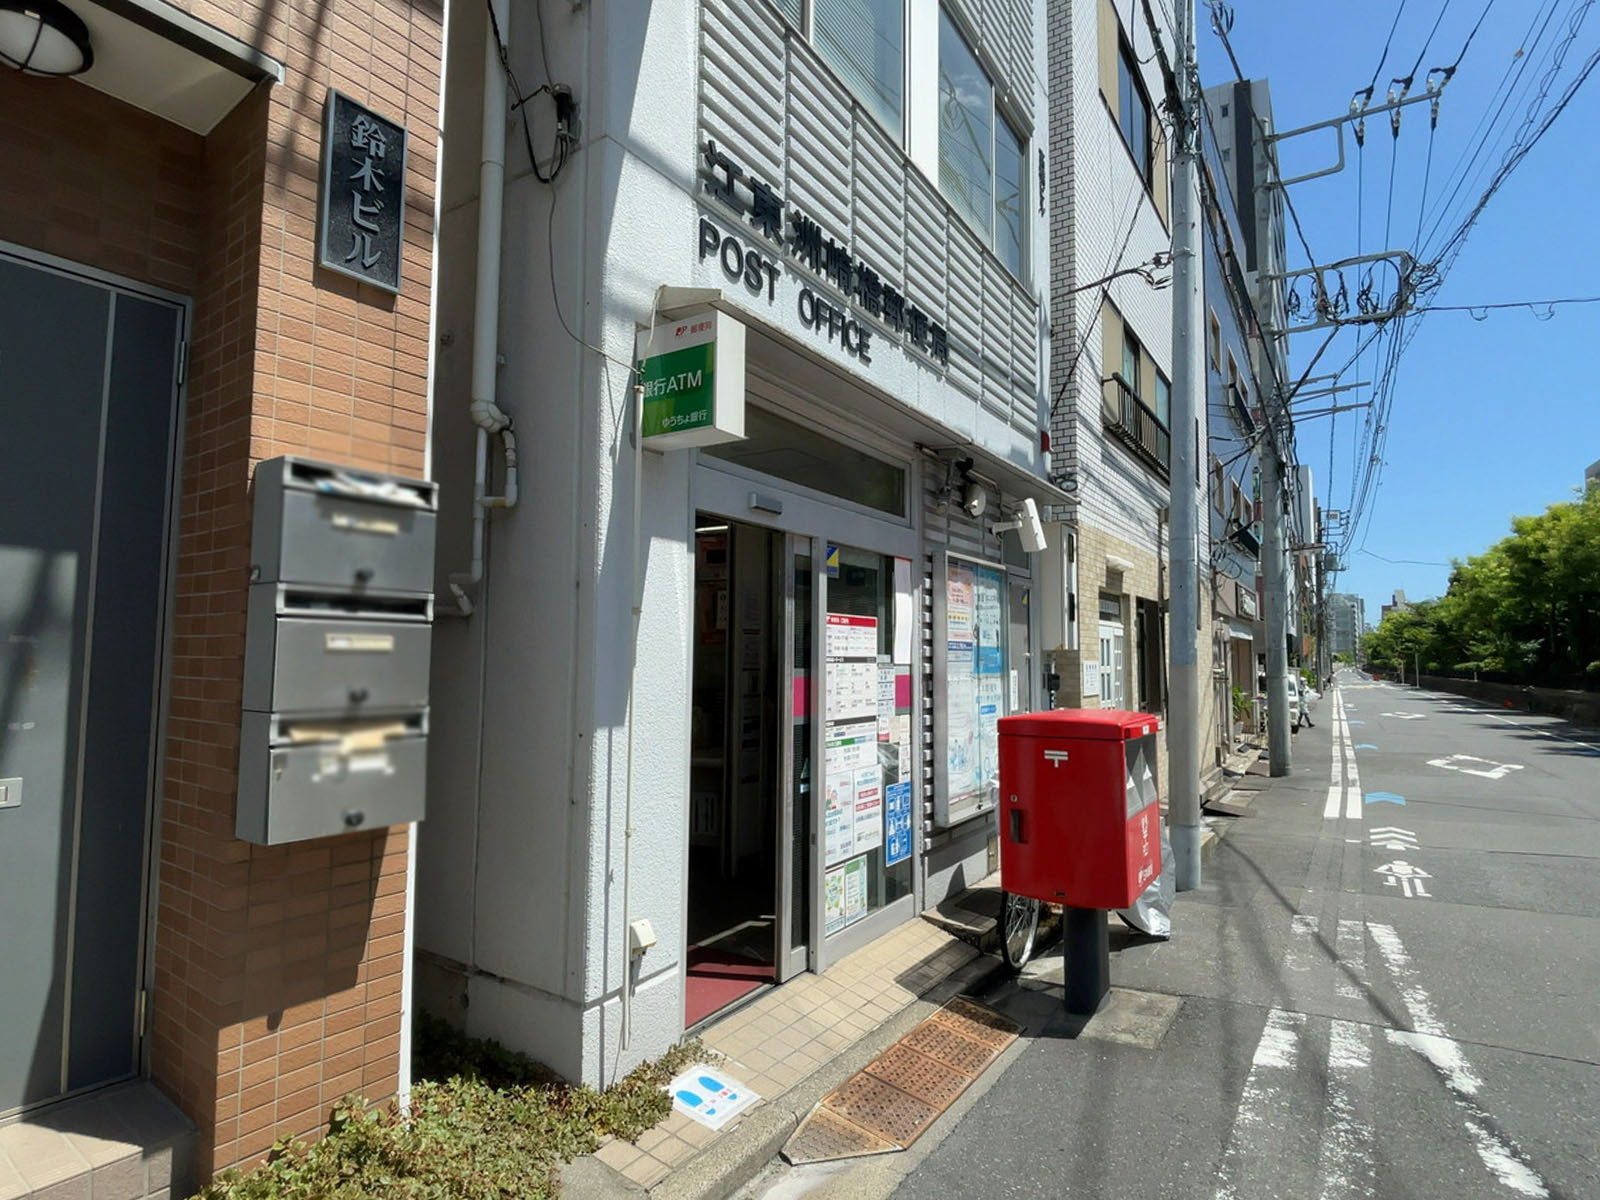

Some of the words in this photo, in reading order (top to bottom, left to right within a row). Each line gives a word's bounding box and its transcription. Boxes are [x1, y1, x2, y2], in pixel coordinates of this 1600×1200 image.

[346, 116, 387, 268] 鈴木ビル
[704, 139, 948, 365] 江東洲崎橋郵便局
[699, 218, 780, 303] POST
[798, 288, 873, 364] OFFICE
[662, 409, 707, 429] ゆうちょ銀行
